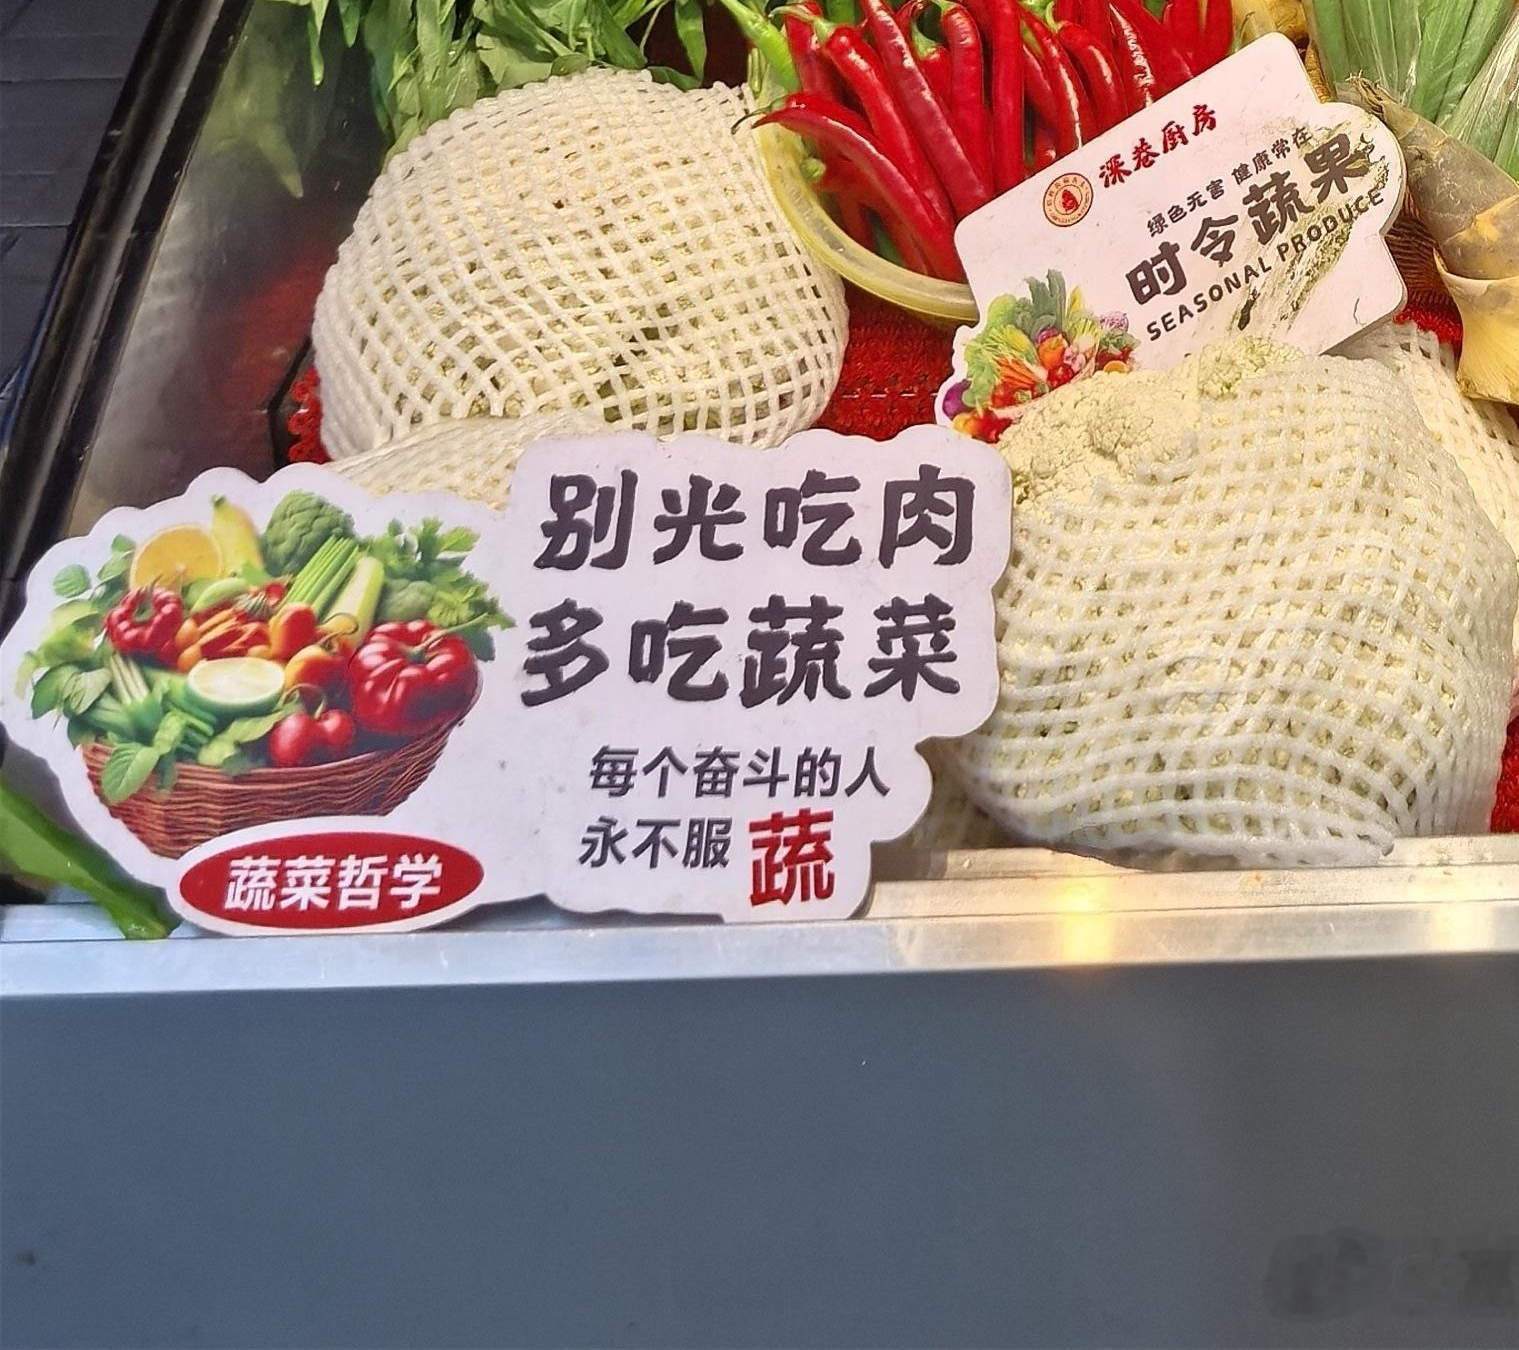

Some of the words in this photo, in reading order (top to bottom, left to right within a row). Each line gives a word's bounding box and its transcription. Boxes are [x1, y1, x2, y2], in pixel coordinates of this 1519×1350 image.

[1098, 103, 1219, 189] 深巷厨房
[1146, 178, 1226, 238] 绿色无害
[1231, 125, 1312, 184] 健康常在
[1125, 133, 1370, 306] 时令蔬果
[1146, 254, 1273, 342] SEASONAL
[1278, 187, 1384, 263] PRODUCE
[538, 464, 979, 571] 别光吃肉
[520, 594, 962, 709] 多吃蔬菜
[588, 745, 890, 800] 每个奋斗的人
[225, 852, 443, 912] 蔬菜哲学
